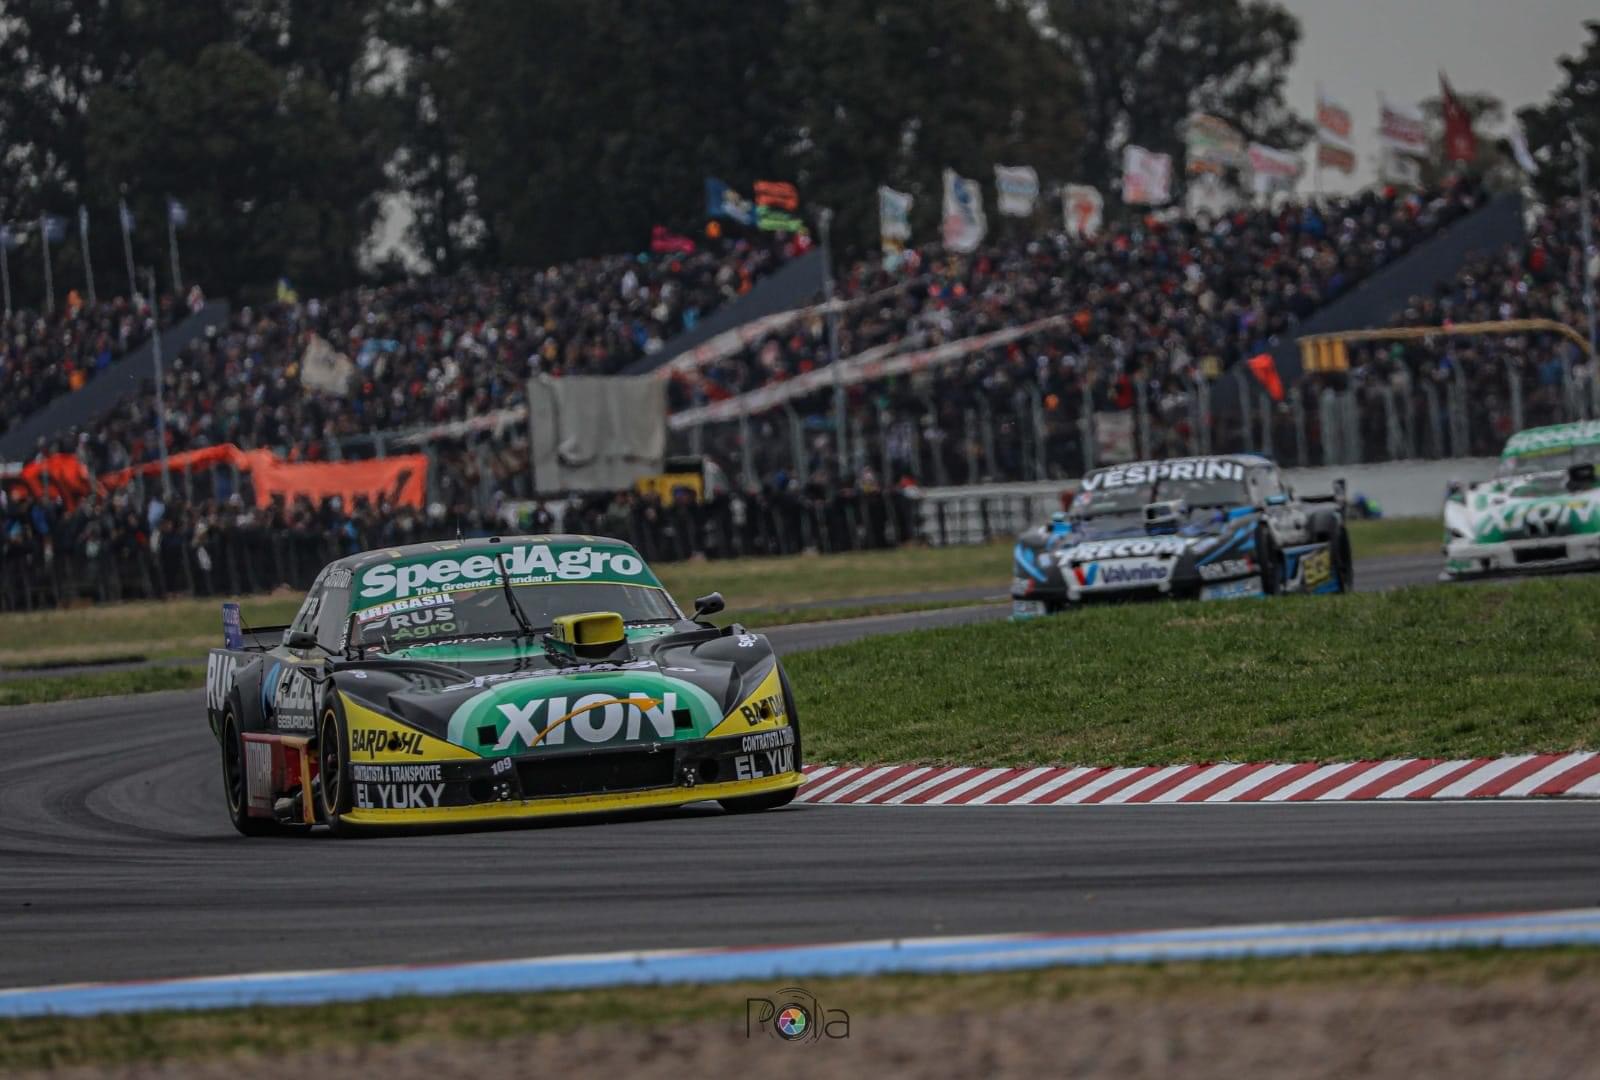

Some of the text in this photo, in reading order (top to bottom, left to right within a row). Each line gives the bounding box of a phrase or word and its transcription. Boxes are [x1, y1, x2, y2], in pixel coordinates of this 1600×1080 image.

[1081, 461, 1244, 490] VESPRINI
[360, 545, 643, 598] SpeedAgro
[416, 586, 439, 596] The
[441, 579, 492, 592] Greener
[390, 607, 455, 629] RUS
[391, 622, 456, 640] Agro
[492, 692, 677, 751] XION
[391, 765, 442, 782] TRANSPORTE
[490, 757, 512, 775] 109
[734, 747, 795, 781] EL YUK
[356, 783, 446, 809] EL YUKY
